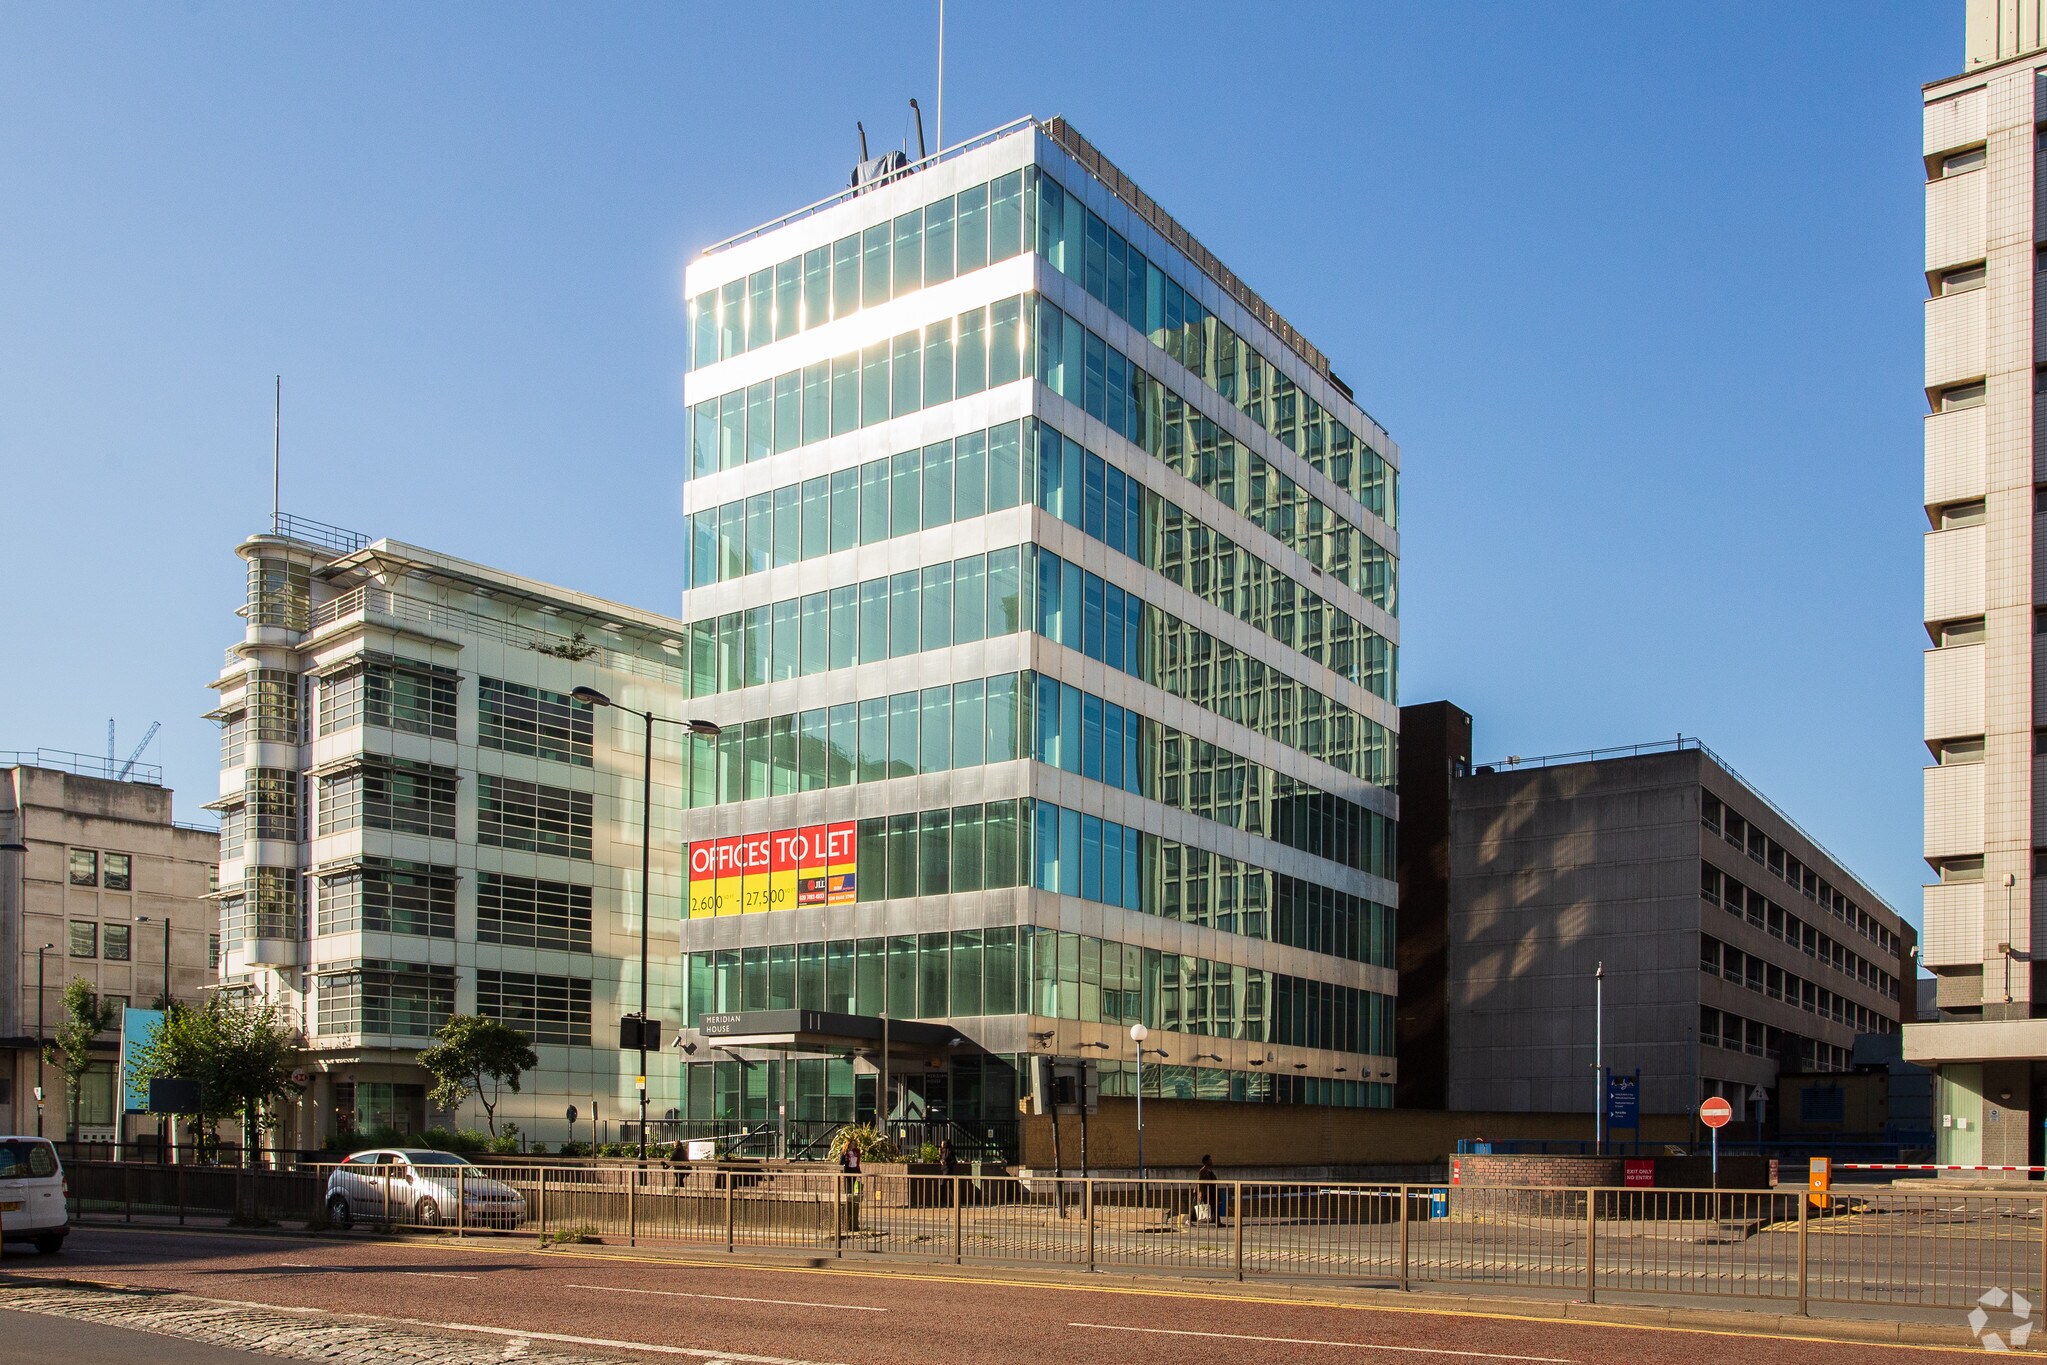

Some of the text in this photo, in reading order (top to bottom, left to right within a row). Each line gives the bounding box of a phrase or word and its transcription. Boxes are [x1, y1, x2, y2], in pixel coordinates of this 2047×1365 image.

[692, 829, 854, 873] OFFICES TO LET
[692, 895, 723, 911] 2,600
[746, 889, 785, 907] 27,500
[706, 1015, 741, 1024] MERIDIAN
[706, 1025, 730, 1033] HOUSE
